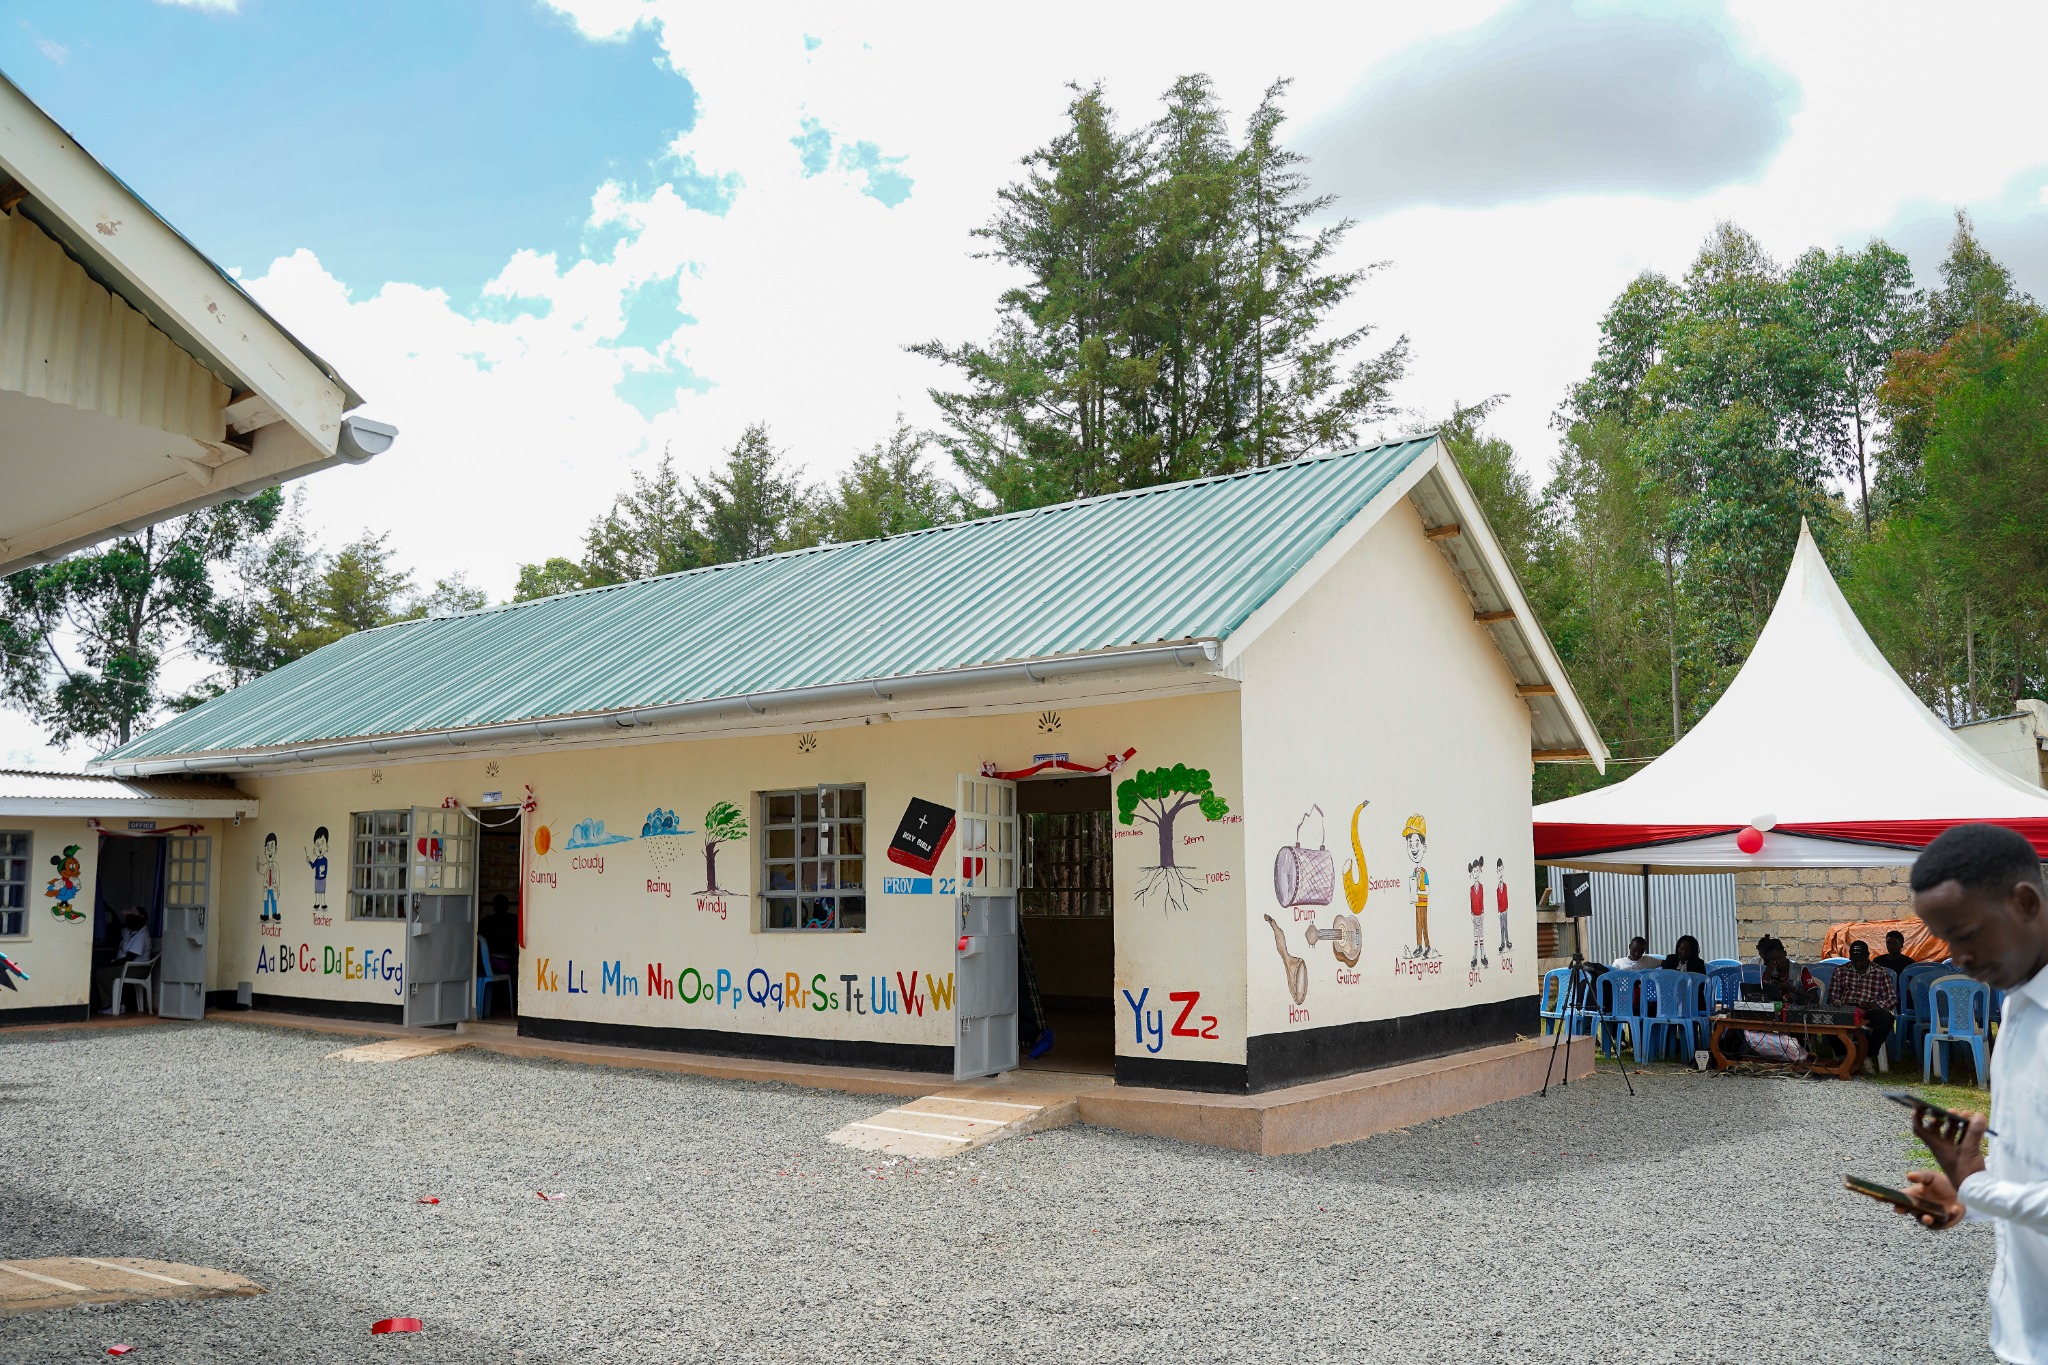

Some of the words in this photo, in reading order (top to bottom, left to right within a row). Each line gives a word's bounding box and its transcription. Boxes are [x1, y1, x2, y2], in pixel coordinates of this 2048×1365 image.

[1114, 829, 1144, 838] branches
[1183, 835, 1204, 845] Stem
[530, 871, 557, 888] Sunny
[1205, 871, 1231, 884] roots
[646, 876, 671, 898] Rainy
[884, 878, 914, 894] PROV
[697, 895, 727, 920] Windy
[1293, 907, 1316, 921] Drum
[312, 912, 333, 927] Teacher
[261, 924, 282, 938] Doctor
[1336, 968, 1362, 985] Guitar
[1394, 957, 1407, 976] An
[1409, 960, 1443, 981] Engineer
[925, 972, 956, 1012] W
[1289, 1004, 1310, 1024] Horn
